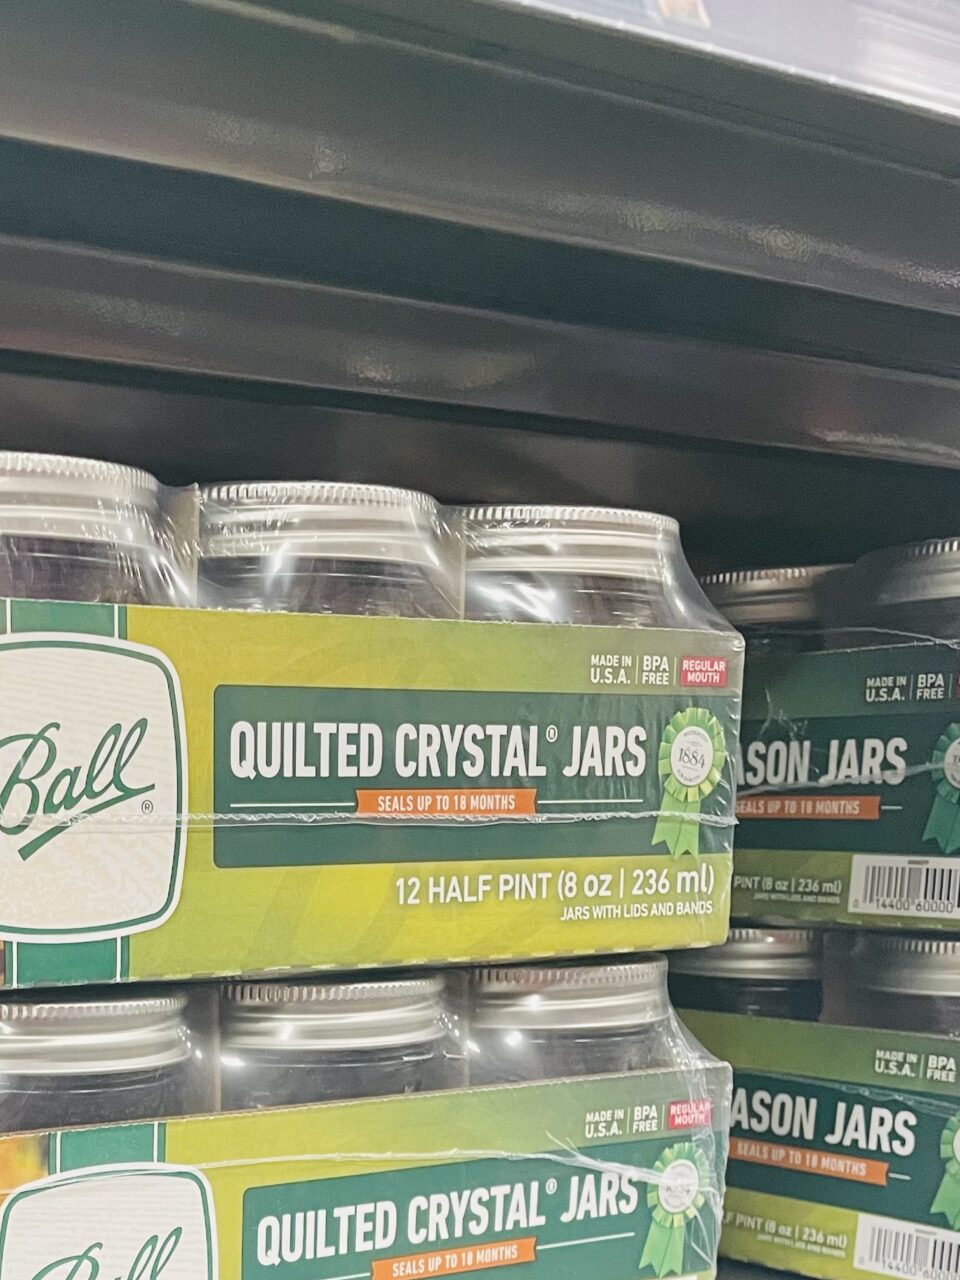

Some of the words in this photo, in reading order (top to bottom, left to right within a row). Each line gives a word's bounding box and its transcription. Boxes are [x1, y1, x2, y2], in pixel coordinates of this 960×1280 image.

[591, 655, 619, 667] MADE
[622, 655, 632, 667] IN
[643, 655, 669, 671] BPA
[682, 660, 726, 672] REGULAR
[591, 668, 631, 684] U.S.A.
[642, 672, 669, 685] FREE
[687, 672, 720, 683] MOUTH
[918, 673, 944, 687] BPA
[916, 687, 945, 700] FREE
[230, 720, 383, 780] QUILTED
[562, 725, 647, 777] JARS
[678, 747, 706, 769] 1884
[818, 737, 908, 786] JARS
[377, 795, 413, 812] SEALS
[417, 795, 432, 812] UP
[435, 795, 450, 811] TO
[454, 794, 466, 811] 18
[470, 794, 515, 811] MONTHS
[815, 799, 860, 815] MONTHS
[396, 876, 420, 905] 12
[428, 874, 493, 904] HALF
[499, 872, 552, 901] PINT
[557, 871, 578, 902] (8
[583, 873, 613, 898] oz
[631, 868, 670, 896] 236
[676, 862, 714, 894] ml)
[560, 905, 589, 921] JARS
[592, 904, 622, 920] WITH
[623, 903, 648, 918] LIDS
[650, 902, 674, 917] AND
[676, 900, 713, 916] BANDS
[928, 1054, 956, 1071] BPA
[926, 1068, 956, 1083] FREE
[633, 1105, 658, 1121] BPA
[632, 1119, 658, 1134] FREE
[824, 1101, 917, 1156] JARS
[257, 1200, 397, 1266] QUILTED
[560, 1173, 638, 1224] JARS
[392, 1259, 425, 1278] SEALS
[428, 1256, 442, 1273] UP
[445, 1254, 459, 1270] TO
[462, 1252, 473, 1267] 18
[476, 1244, 518, 1264] MONTHS
